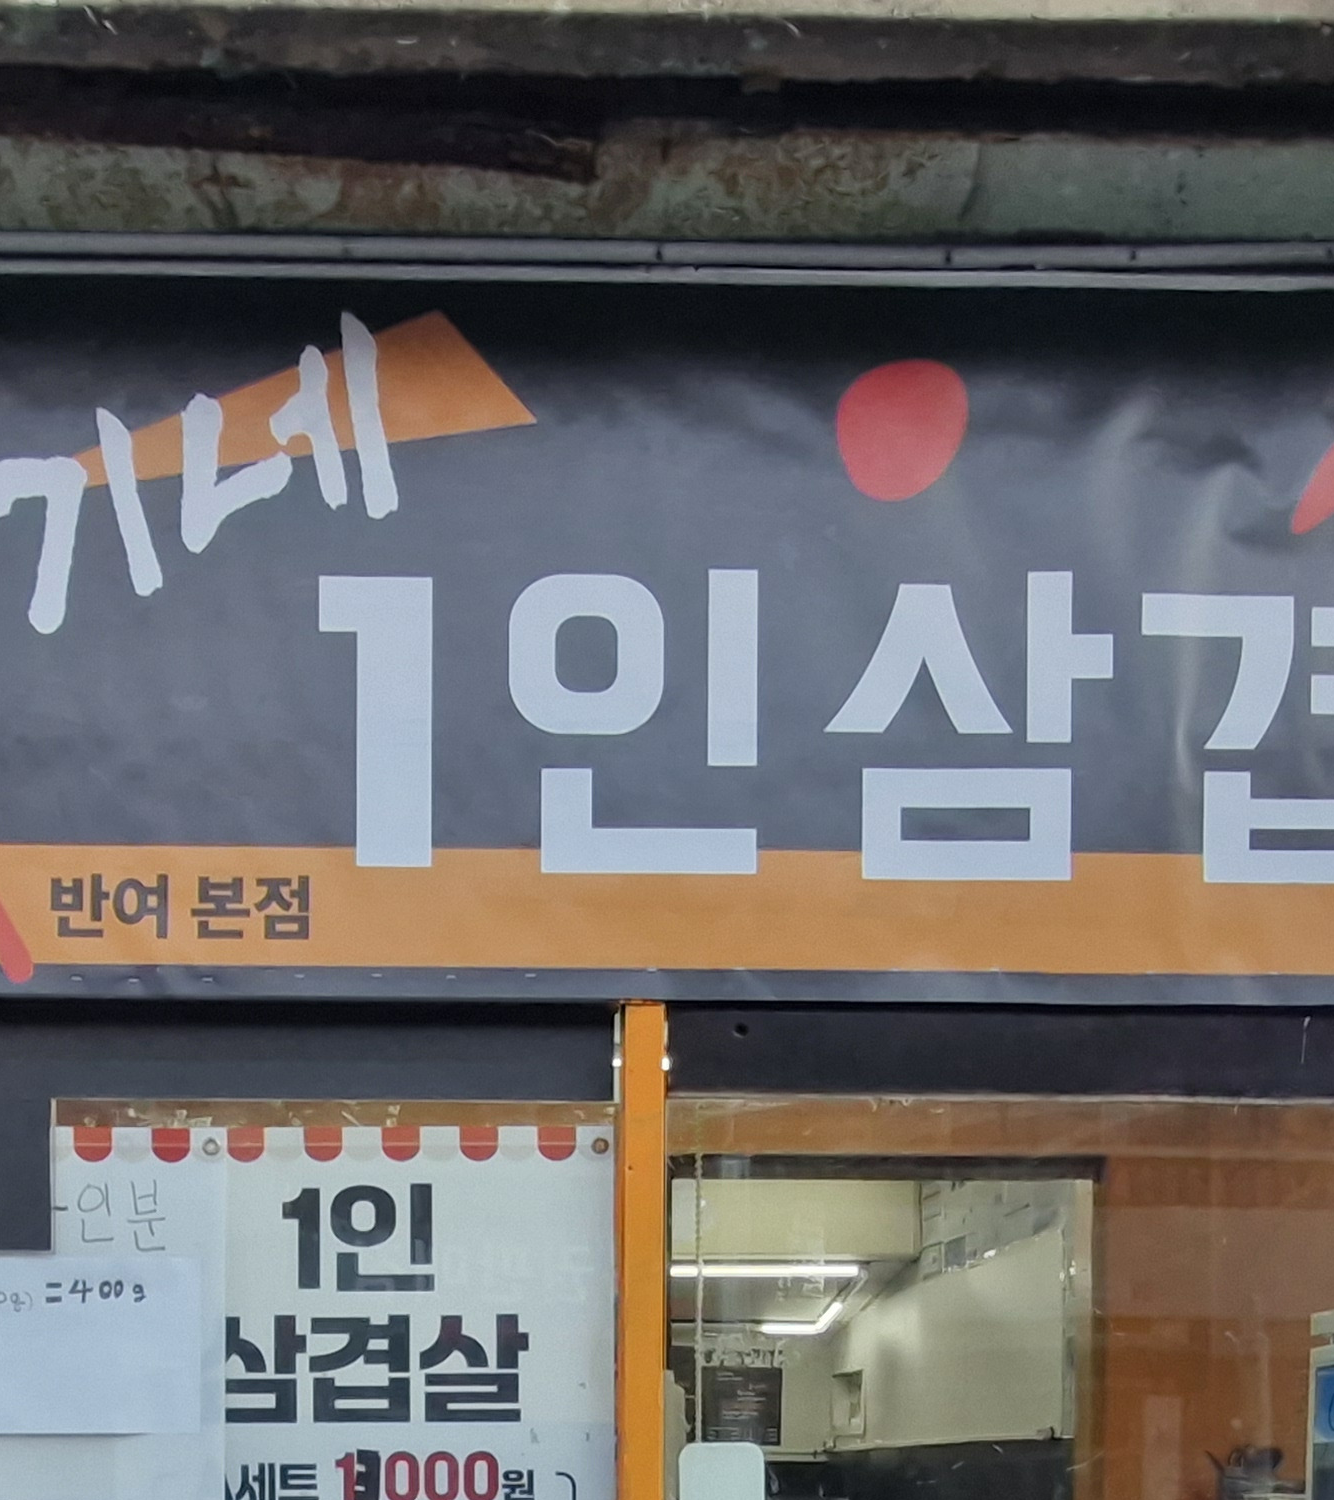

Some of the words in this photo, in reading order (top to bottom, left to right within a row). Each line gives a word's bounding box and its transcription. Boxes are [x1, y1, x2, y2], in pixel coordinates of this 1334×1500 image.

[49, 873, 170, 939] 반여
[189, 873, 312, 939] 본점
[281, 1181, 436, 1292] 1인
